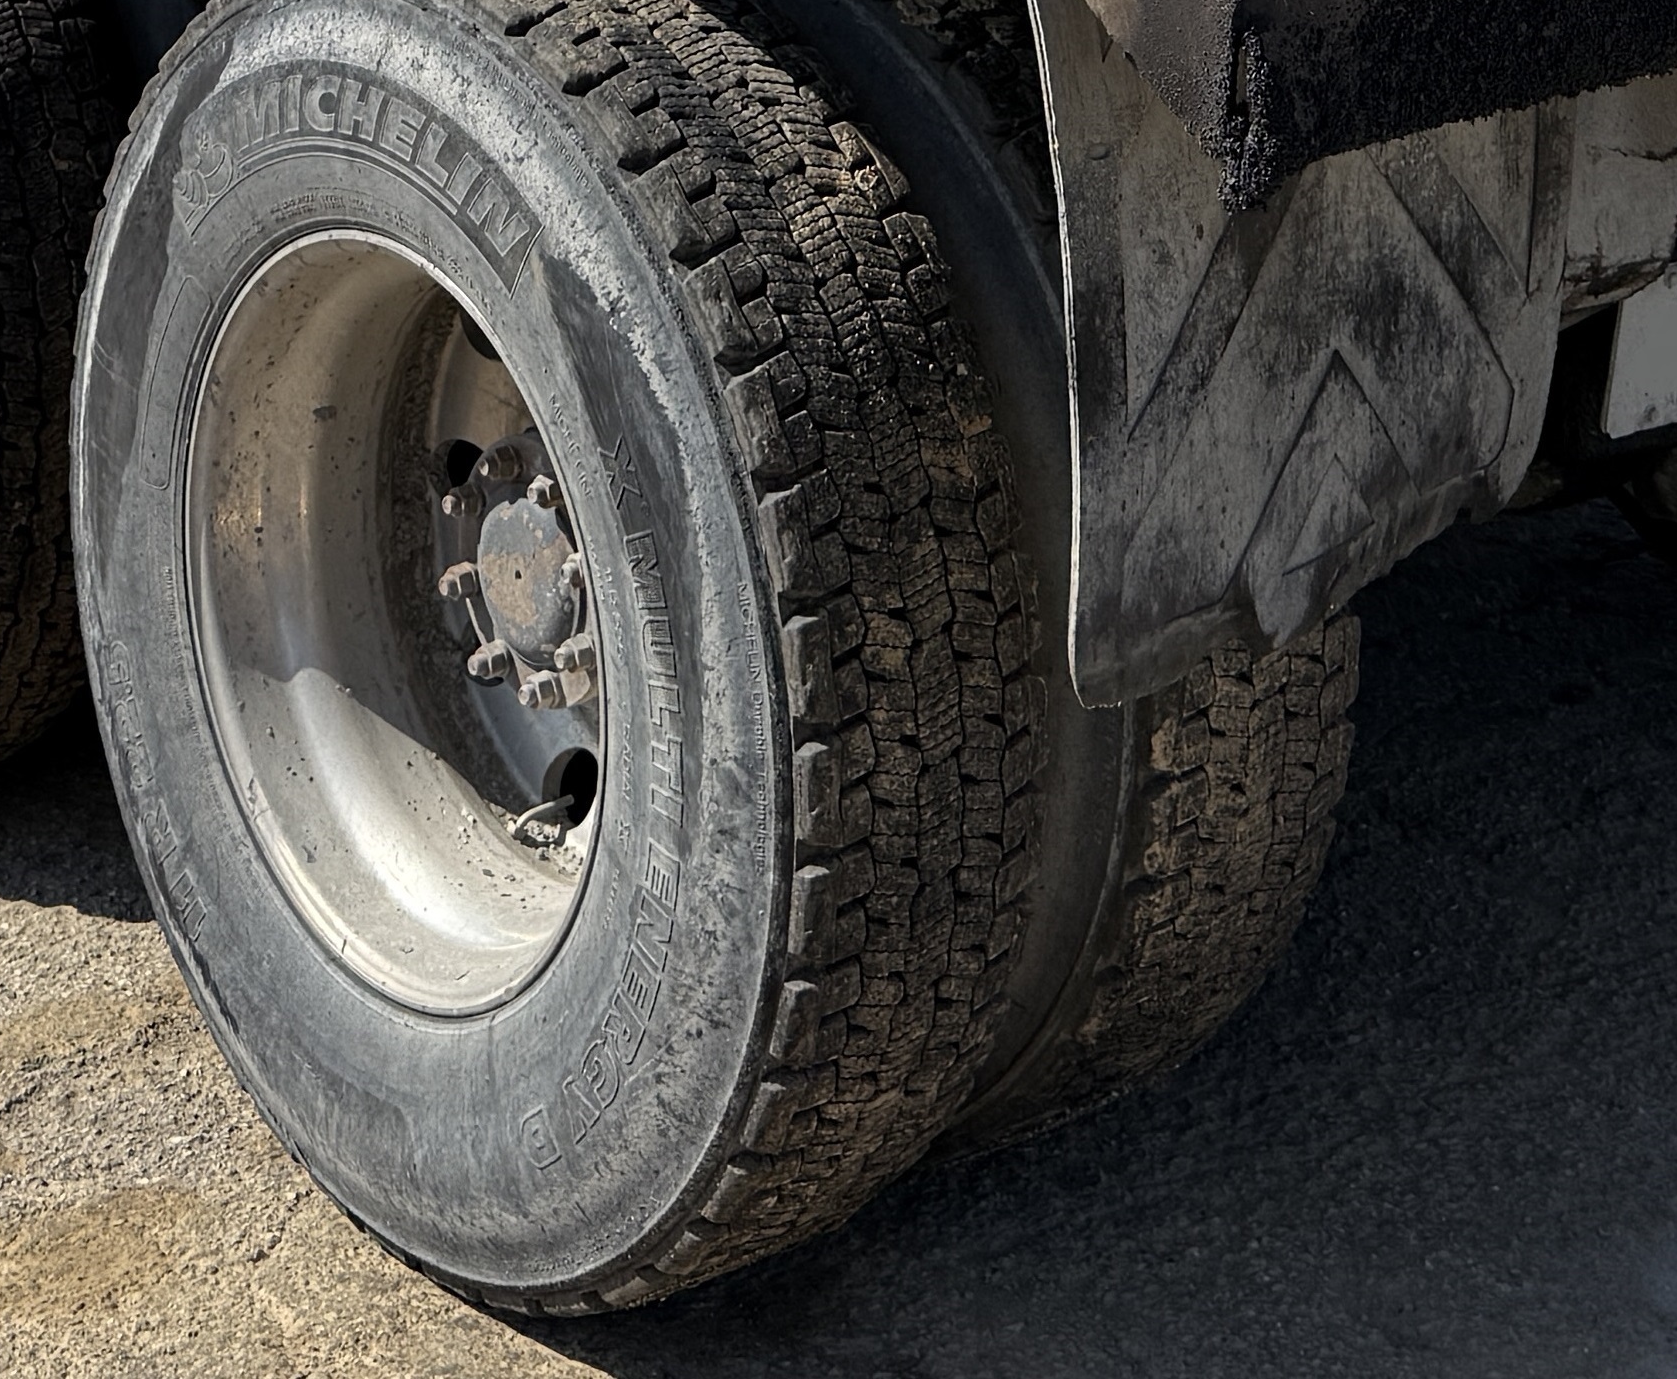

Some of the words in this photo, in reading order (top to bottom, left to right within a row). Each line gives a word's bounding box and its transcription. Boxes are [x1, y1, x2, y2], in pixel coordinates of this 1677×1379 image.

[233, 74, 530, 258] MICHELIN
[596, 434, 643, 510] X
[624, 529, 683, 829] MULTI
[562, 836, 681, 1145] ENERGY
